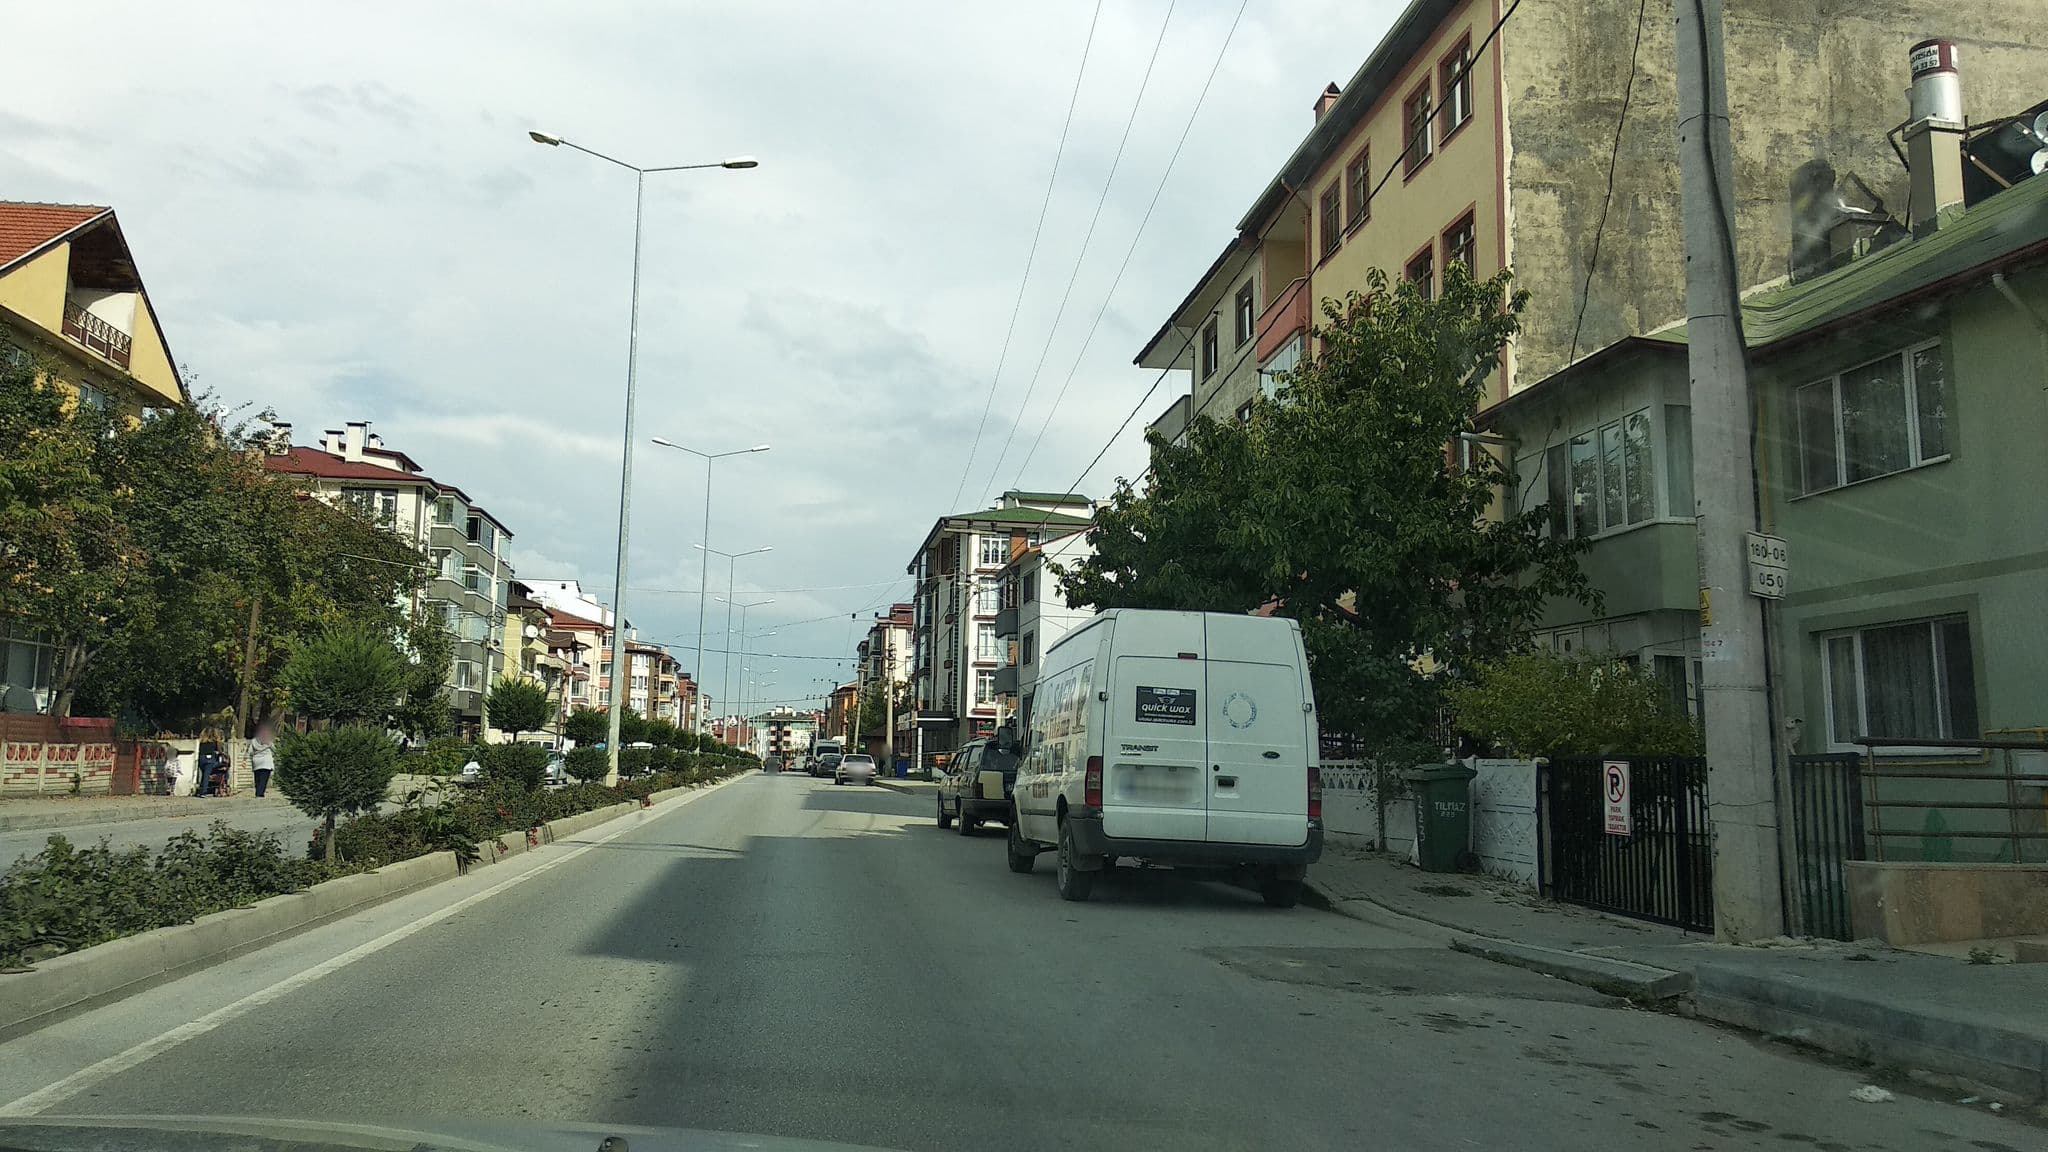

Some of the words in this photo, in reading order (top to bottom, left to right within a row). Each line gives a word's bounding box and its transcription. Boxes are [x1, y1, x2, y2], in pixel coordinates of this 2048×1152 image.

[1759, 572, 1784, 588] 050
[1141, 703, 1168, 711] quick
[1169, 705, 1191, 713] wax
[1120, 743, 1159, 752] TRANSIT
[1434, 801, 1466, 812] YILMAZ
